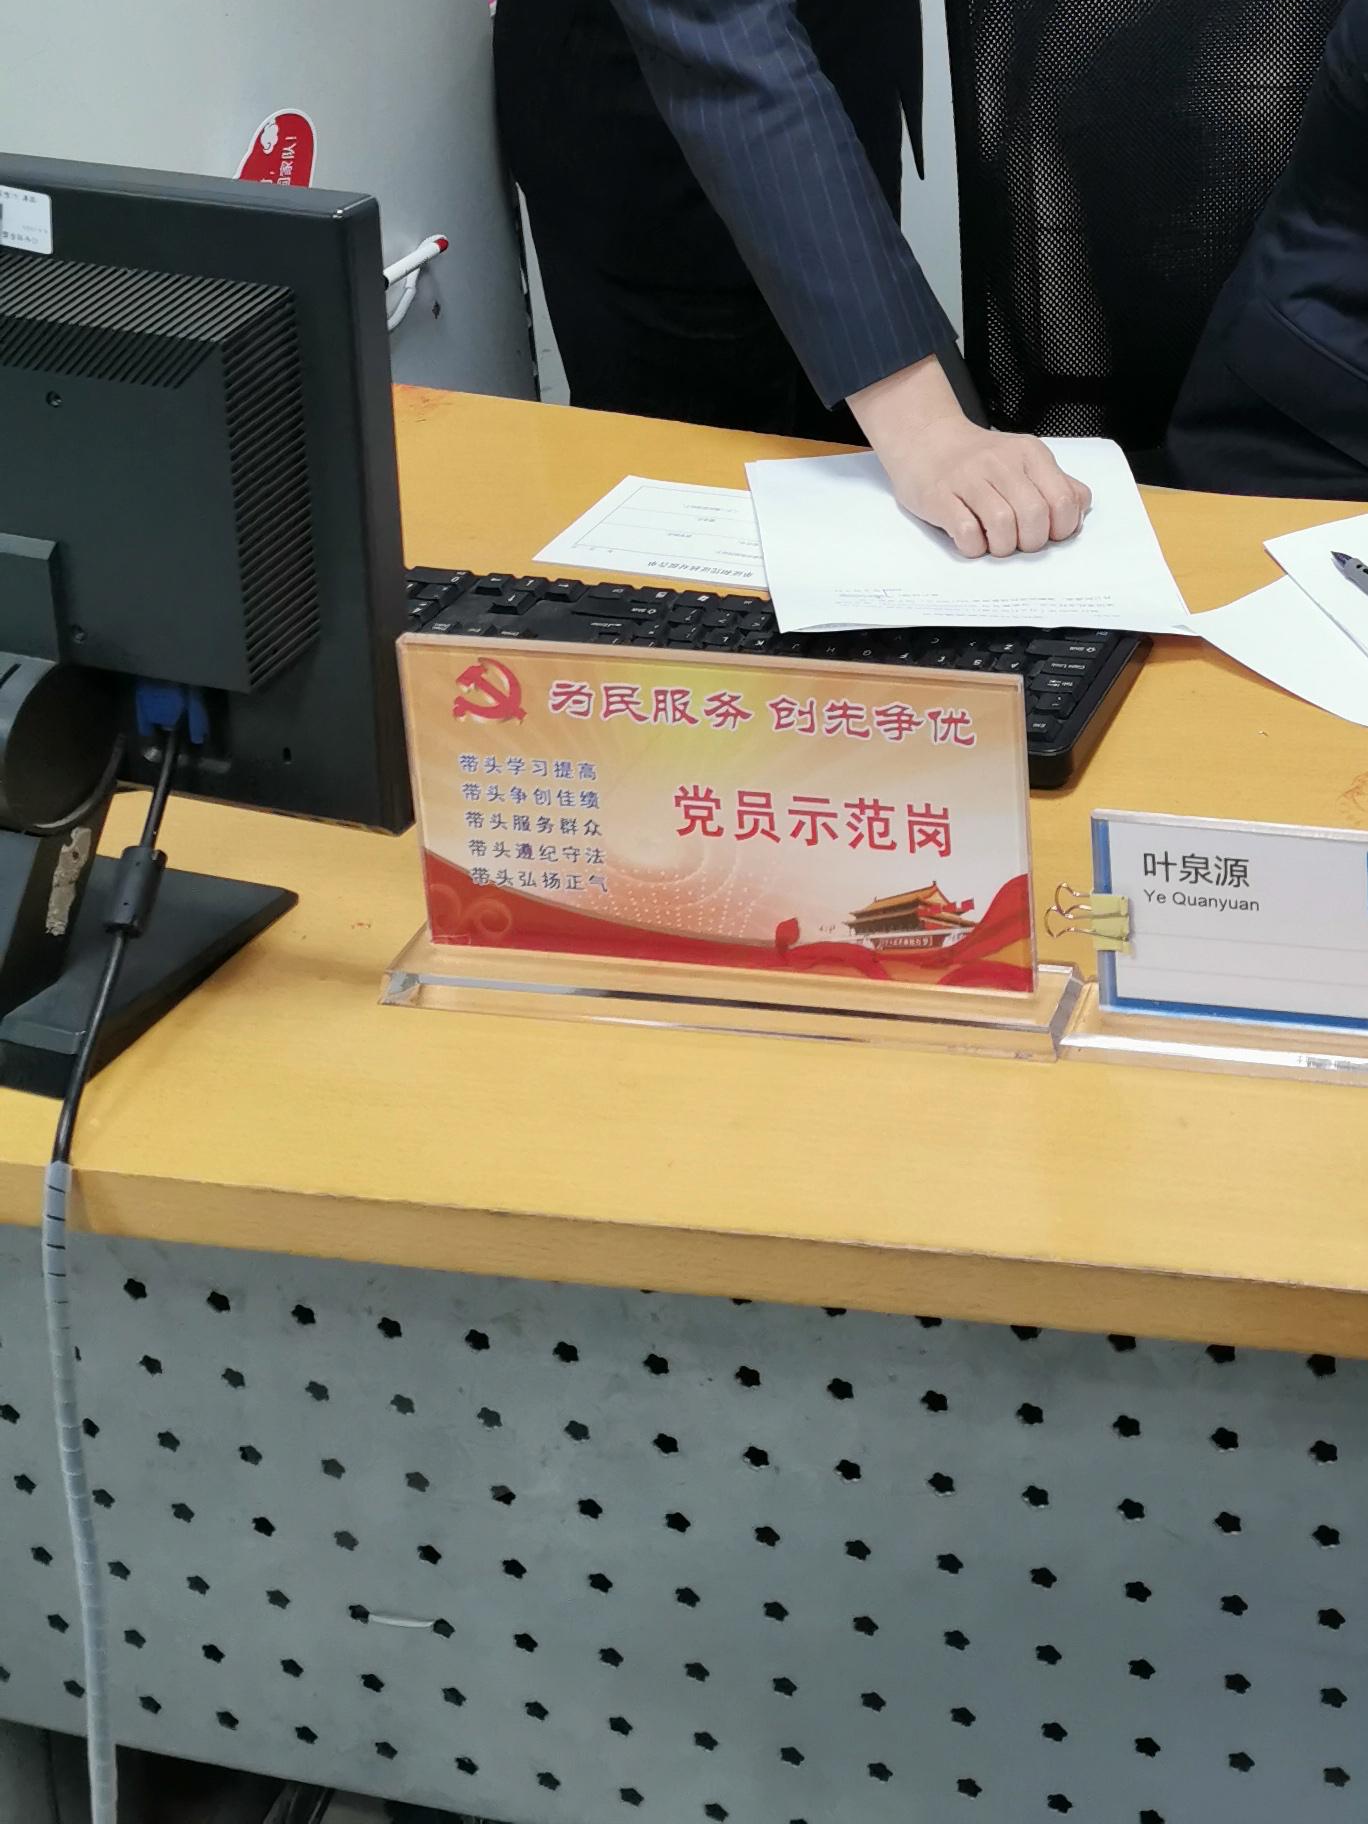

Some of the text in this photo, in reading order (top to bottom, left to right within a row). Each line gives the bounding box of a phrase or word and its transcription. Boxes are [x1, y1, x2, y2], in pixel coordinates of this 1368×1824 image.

[549, 680, 977, 747] 为民服务 创先争优
[459, 754, 598, 781] 带头学习提高
[461, 783, 601, 810] 带头争创佳绩
[464, 811, 603, 837] 带头服务群众
[673, 784, 953, 858] 党员示范岗
[467, 839, 607, 865] 带头遵纪守法
[470, 867, 609, 893] 带头弘扬正气
[1142, 851, 1251, 889] 叶泉源
[1143, 889, 1261, 913] Ye Quanyuan
